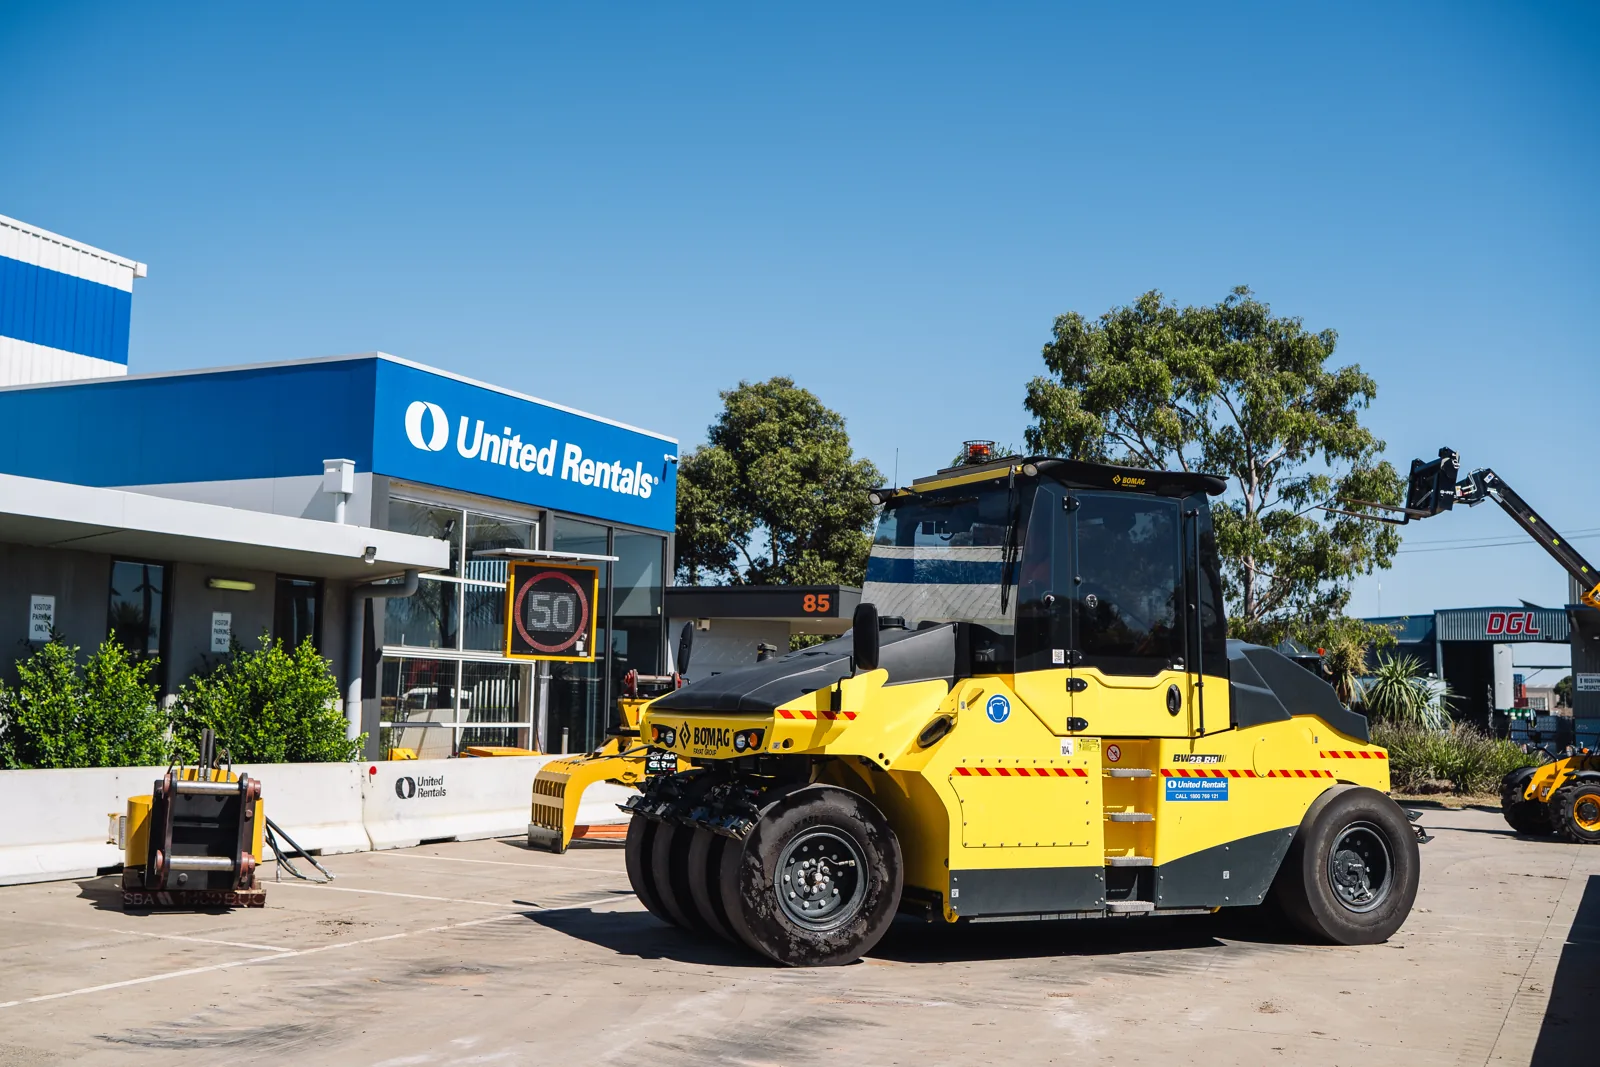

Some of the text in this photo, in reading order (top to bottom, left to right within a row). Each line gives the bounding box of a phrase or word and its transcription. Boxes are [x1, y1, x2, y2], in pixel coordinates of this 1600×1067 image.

[456, 415, 558, 477] United
[1122, 476, 1146, 486] BOMAG
[33, 603, 52, 611] VISITOR
[803, 594, 830, 612] 85
[531, 594, 573, 629] 50
[34, 624, 47, 632] ONLY
[1485, 612, 1540, 635] DGL
[693, 726, 730, 747] BOMAG
[1204, 755, 1218, 764] RH
[417, 775, 444, 787] United
[1177, 780, 1226, 789] United Rentals
[417, 786, 447, 798] Rentals
[124, 892, 155, 905] SBA
